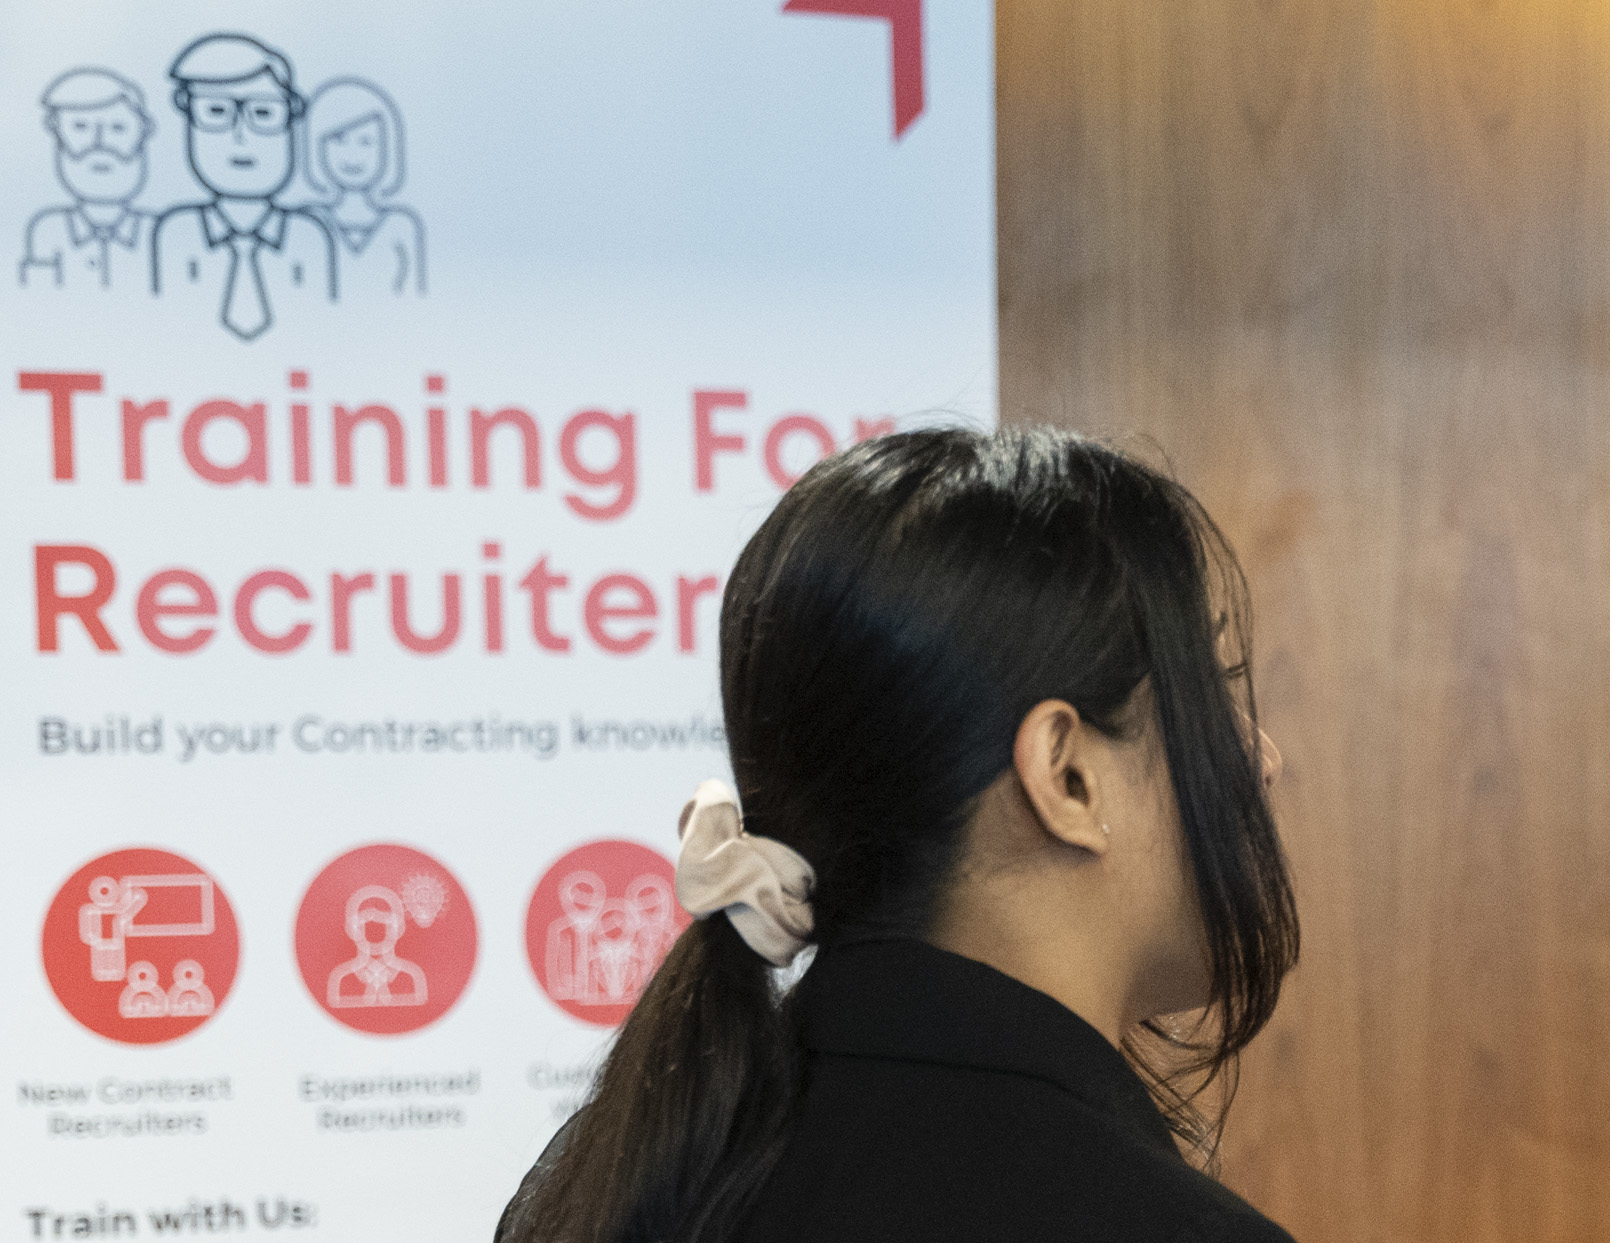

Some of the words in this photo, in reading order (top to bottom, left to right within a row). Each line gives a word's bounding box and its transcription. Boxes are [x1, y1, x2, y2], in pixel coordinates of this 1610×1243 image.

[17, 369, 641, 522] Training
[33, 541, 719, 656] Recruiter
[38, 715, 163, 756] Build
[178, 721, 278, 764] your
[294, 713, 558, 763] Contracting
[18, 1079, 90, 1105] New
[99, 1074, 234, 1105] Contract
[300, 1067, 481, 1101] Experienced
[47, 1109, 208, 1138] Recruiters
[318, 1104, 466, 1133] Recruiters
[26, 1204, 137, 1239] Train
[149, 1199, 245, 1234] with
